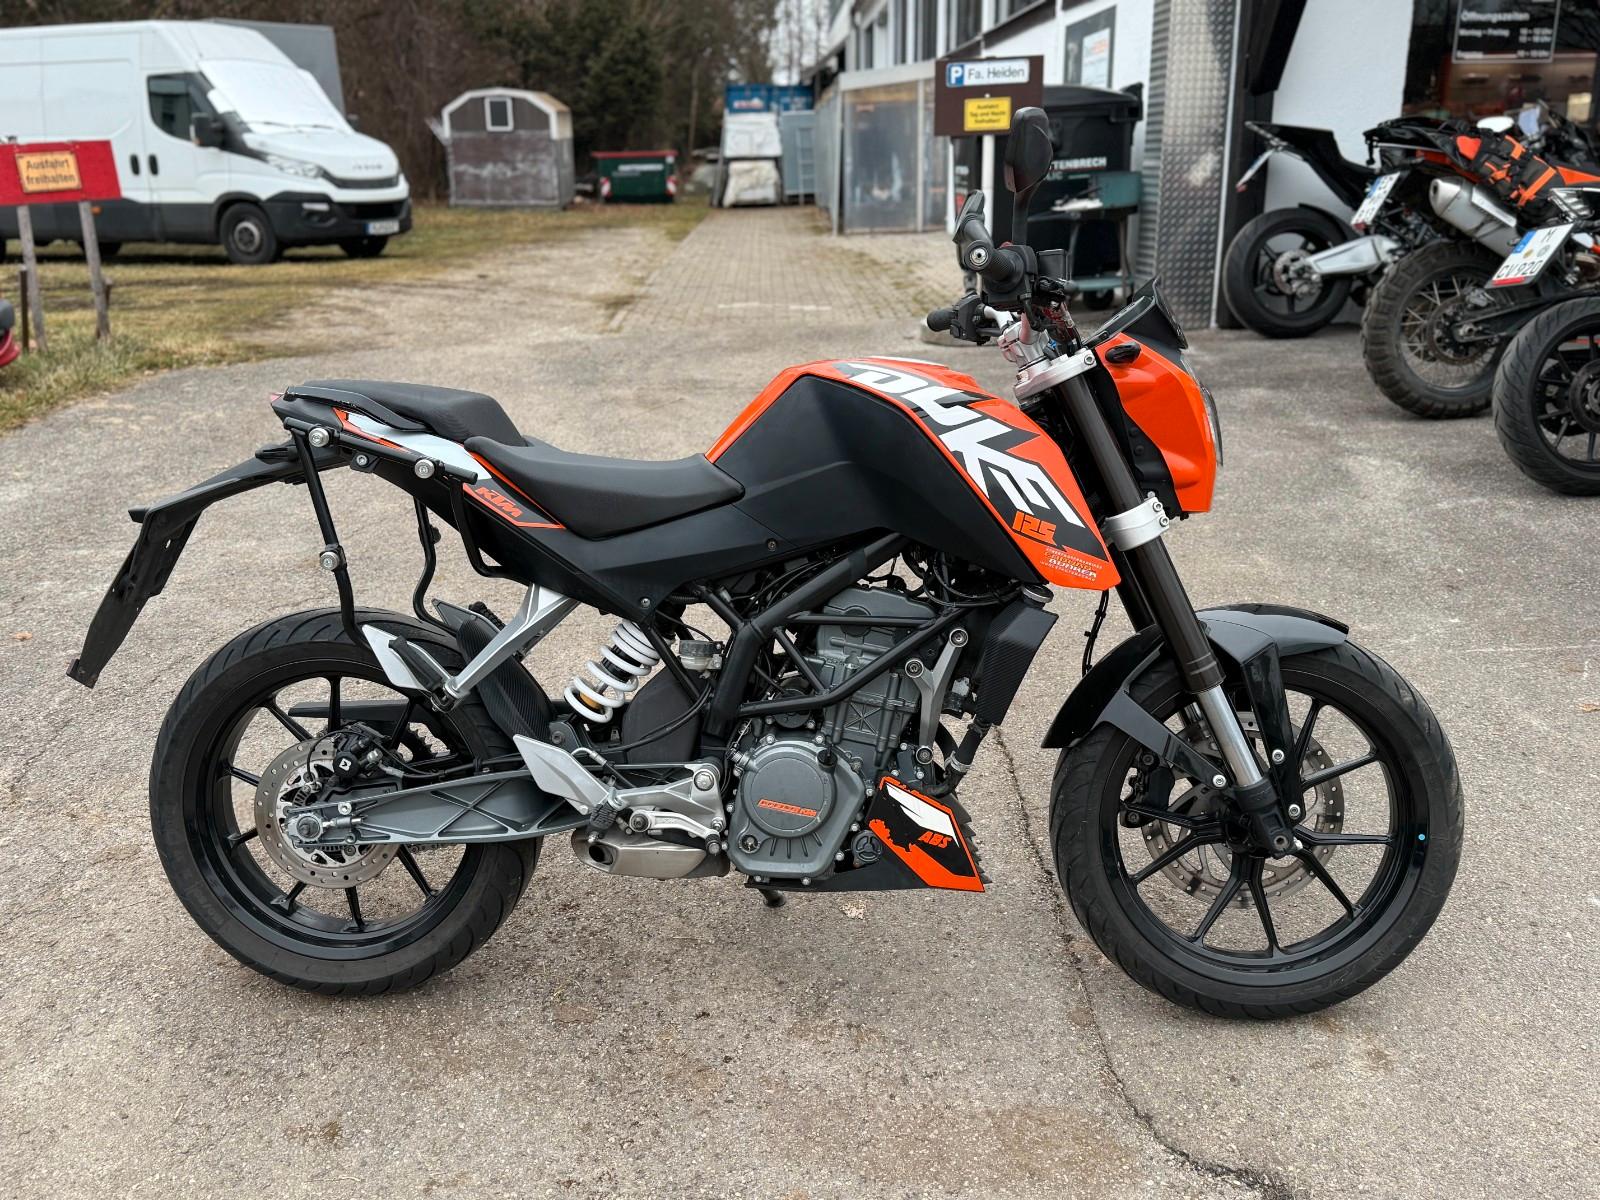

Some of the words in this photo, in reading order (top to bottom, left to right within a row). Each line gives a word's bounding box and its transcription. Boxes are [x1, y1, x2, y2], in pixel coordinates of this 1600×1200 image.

[968, 68, 984, 80] Fa.
[987, 65, 1025, 79] Heiden
[26, 158, 70, 170] Ausfahrt
[26, 173, 76, 185] freihalten
[847, 362, 1086, 528] DUKE
[475, 486, 523, 518] KTM
[1012, 510, 1057, 547] 125
[918, 830, 952, 849] ABS
